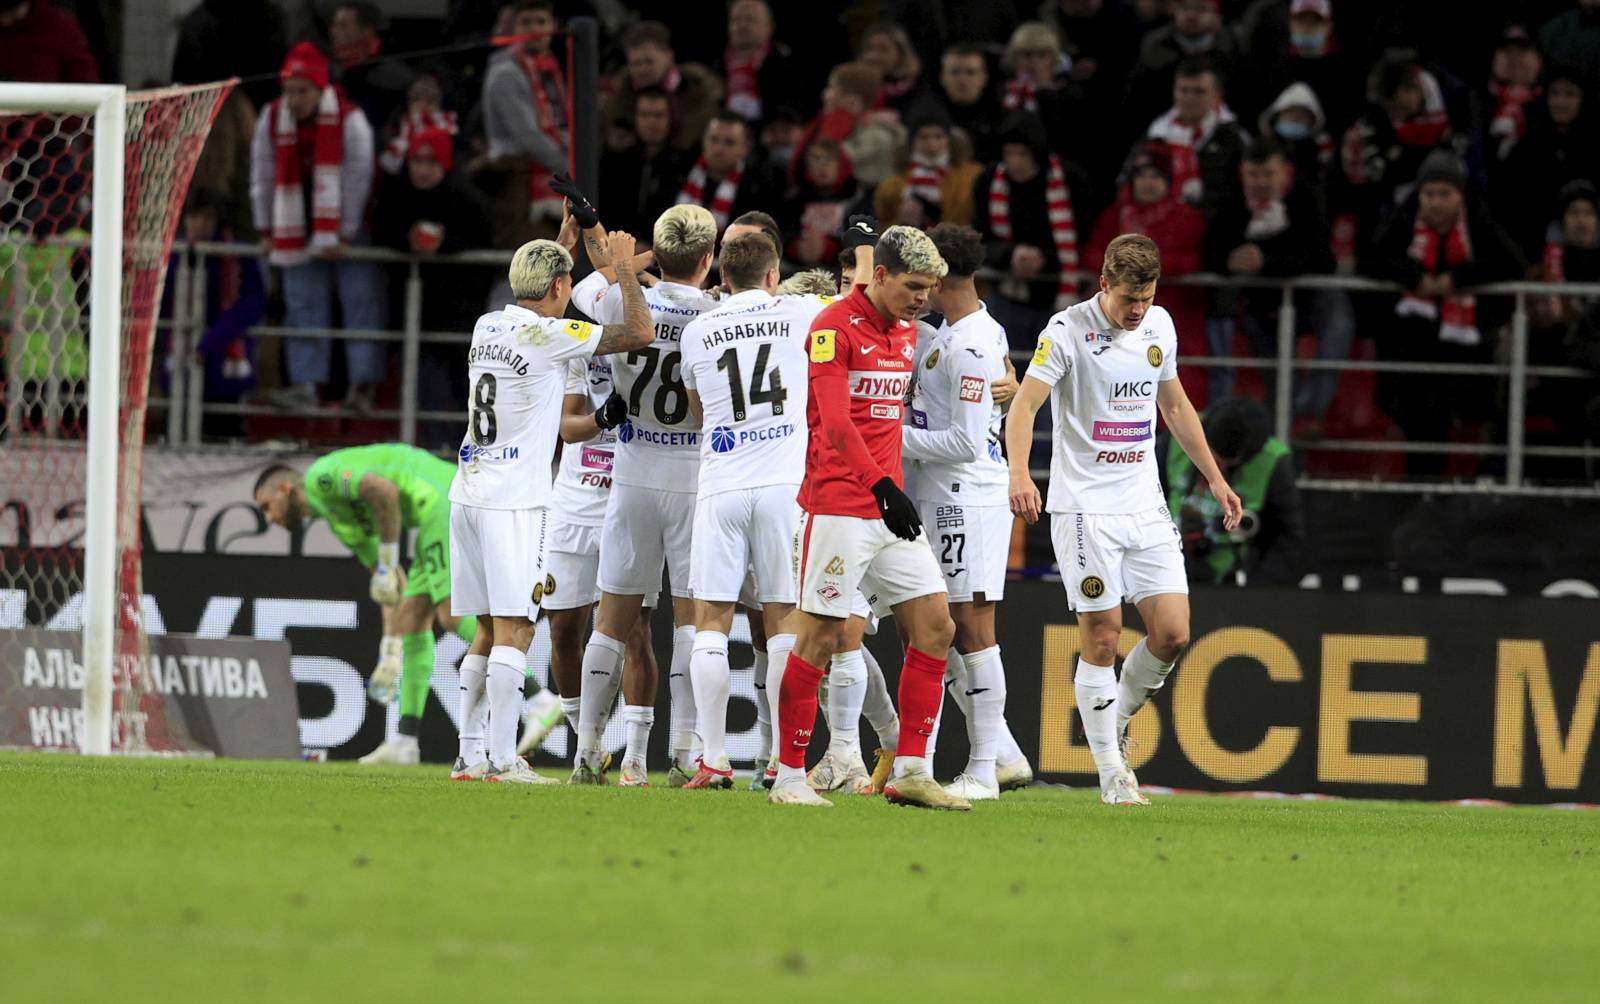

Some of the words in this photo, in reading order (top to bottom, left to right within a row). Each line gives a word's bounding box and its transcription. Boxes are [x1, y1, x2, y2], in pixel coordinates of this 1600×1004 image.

[702, 321, 790, 350] НАБАБКИН
[468, 343, 530, 376] РРАСКАЛЬ
[627, 346, 689, 425] 78
[716, 343, 787, 422] 14
[960, 388, 982, 400] BET
[961, 379, 983, 390] FON
[1114, 381, 1152, 398] ИКС
[473, 372, 497, 447] 8
[637, 428, 697, 445] РОССЕТИ
[740, 424, 796, 444] РОССЕТИ
[1096, 450, 1145, 464] FONBE
[581, 472, 612, 488] FON
[936, 505, 963, 517] ВЭБ
[941, 533, 965, 564] 27
[23, 647, 268, 698] АЛЬРНАТИВА
[1038, 624, 1428, 785] ВСЕ
